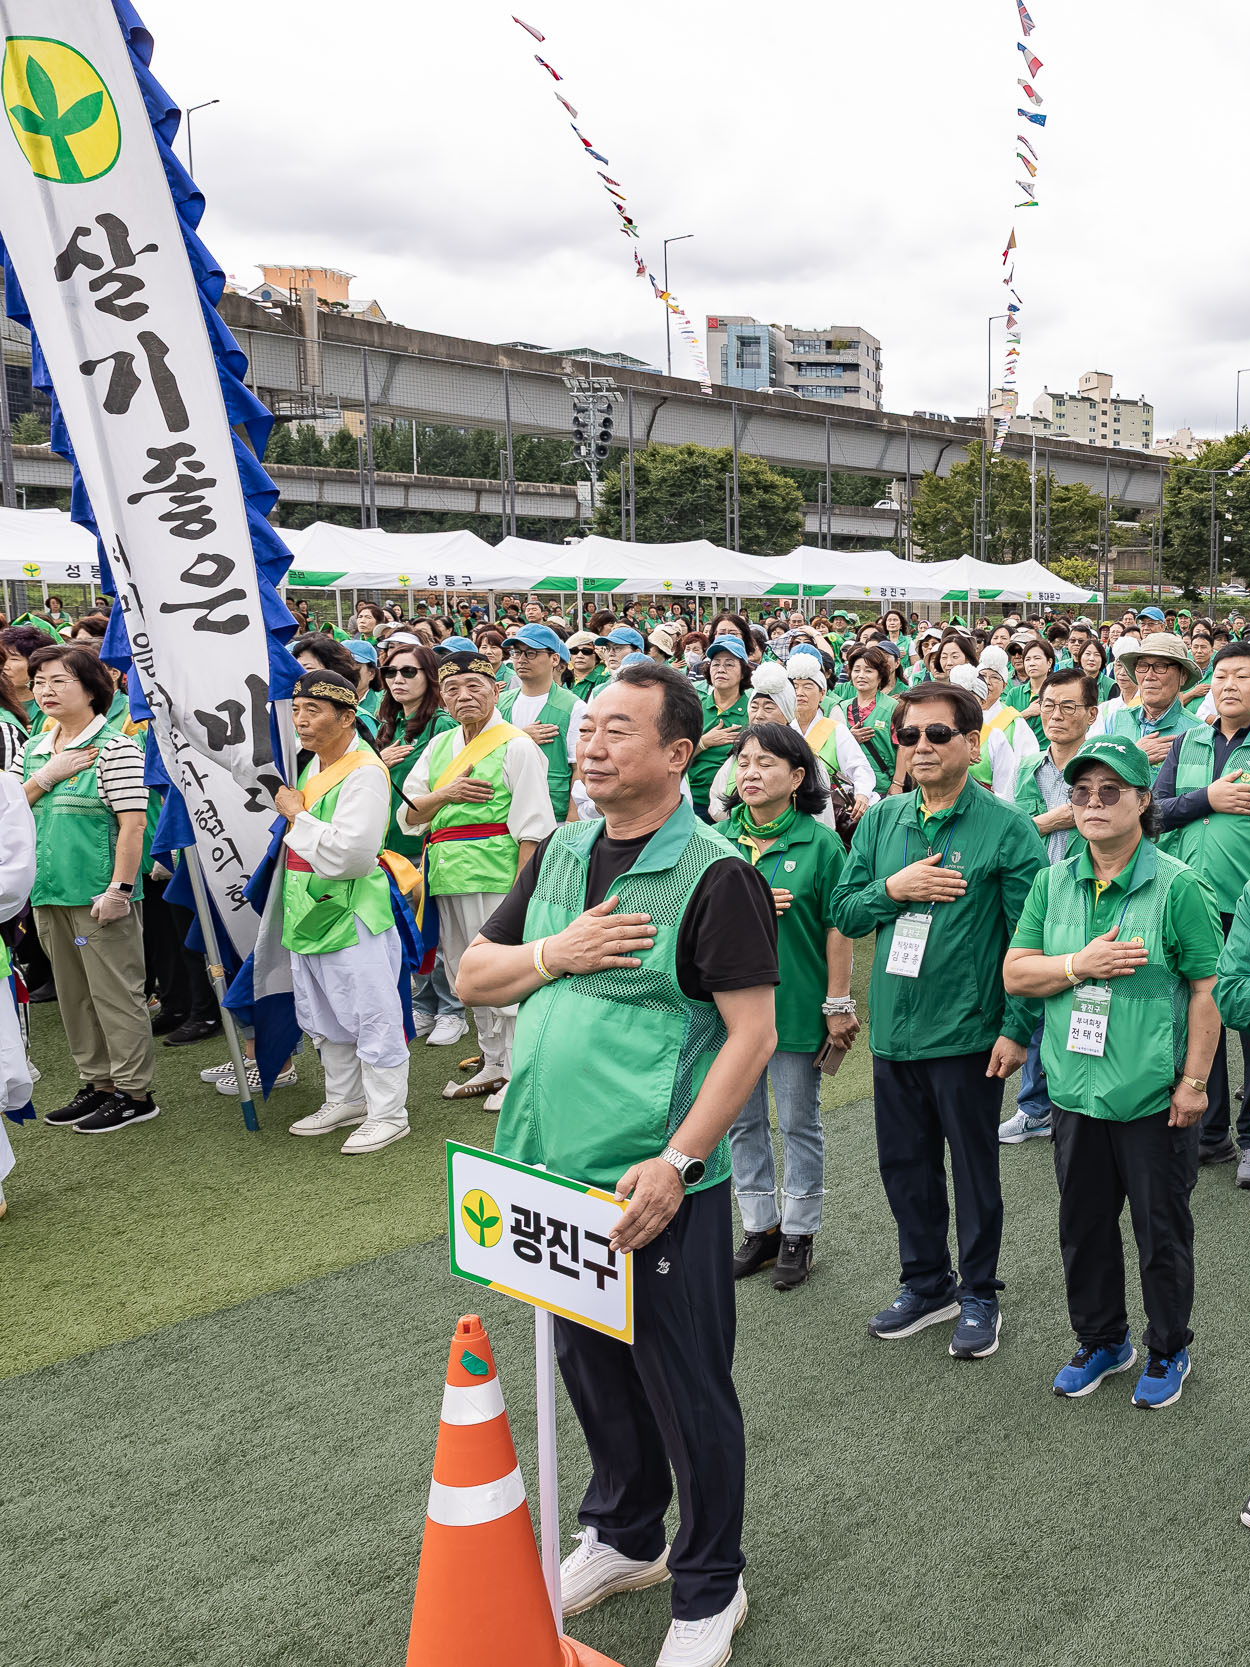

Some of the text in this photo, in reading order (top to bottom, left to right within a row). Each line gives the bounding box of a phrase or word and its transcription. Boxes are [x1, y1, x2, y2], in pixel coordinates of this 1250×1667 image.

[427, 574, 473, 587] 성동구
[684, 581, 719, 591] 성동구
[880, 587, 907, 598] 광진구
[510, 1203, 619, 1292] 광진구
